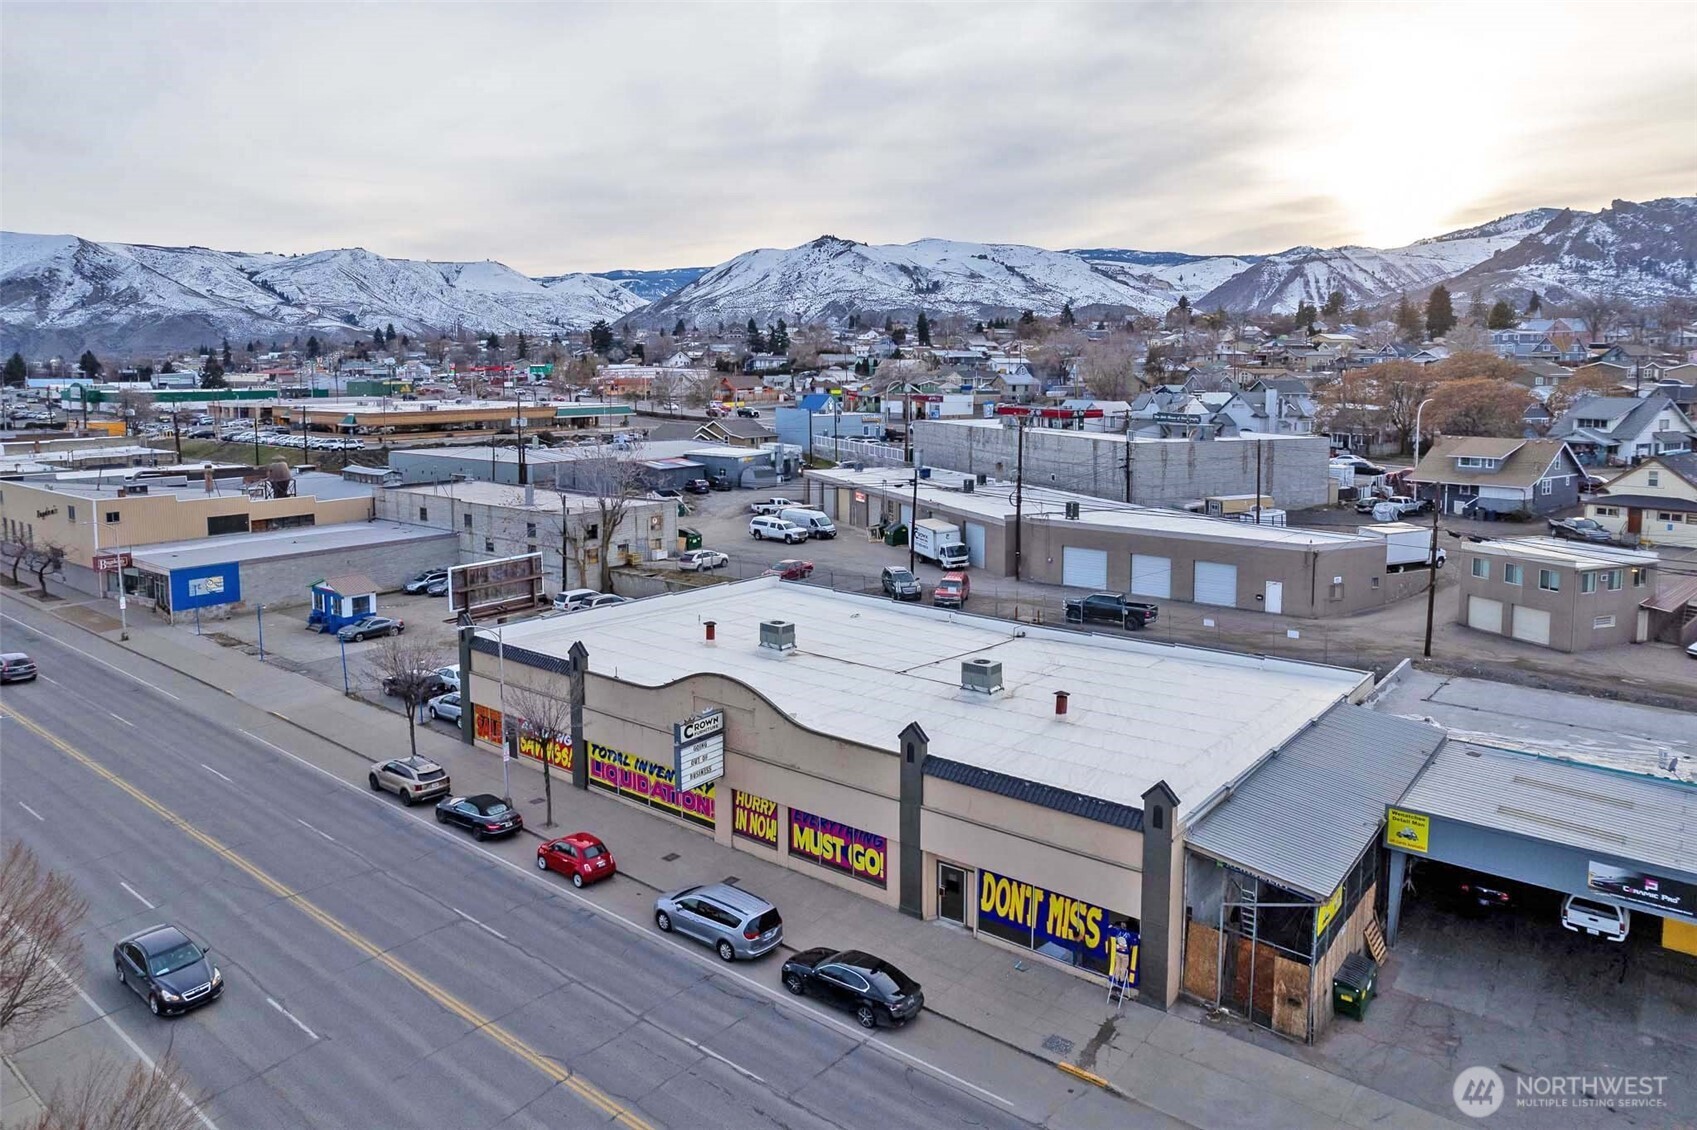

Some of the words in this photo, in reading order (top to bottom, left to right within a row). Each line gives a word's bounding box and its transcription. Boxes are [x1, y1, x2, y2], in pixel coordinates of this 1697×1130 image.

[684, 716, 719, 739] CROWN
[694, 725, 719, 736] FURNITURE
[591, 743, 631, 766] TOTAL
[693, 742, 708, 751] GOING
[691, 758, 702, 766] OUT
[702, 755, 708, 763] OF
[690, 766, 712, 780] BUSINESS
[590, 758, 716, 819] LIQUIDATION!
[736, 790, 777, 816] HURRY
[736, 807, 748, 831] IN
[748, 815, 777, 842] NOW!
[793, 810, 884, 849] EVERYTHING
[1392, 816, 1411, 824] Detail
[793, 823, 845, 863] MUST
[849, 843, 884, 878] GO!
[981, 871, 1044, 928] DON'T
[1047, 893, 1103, 949] MISS
